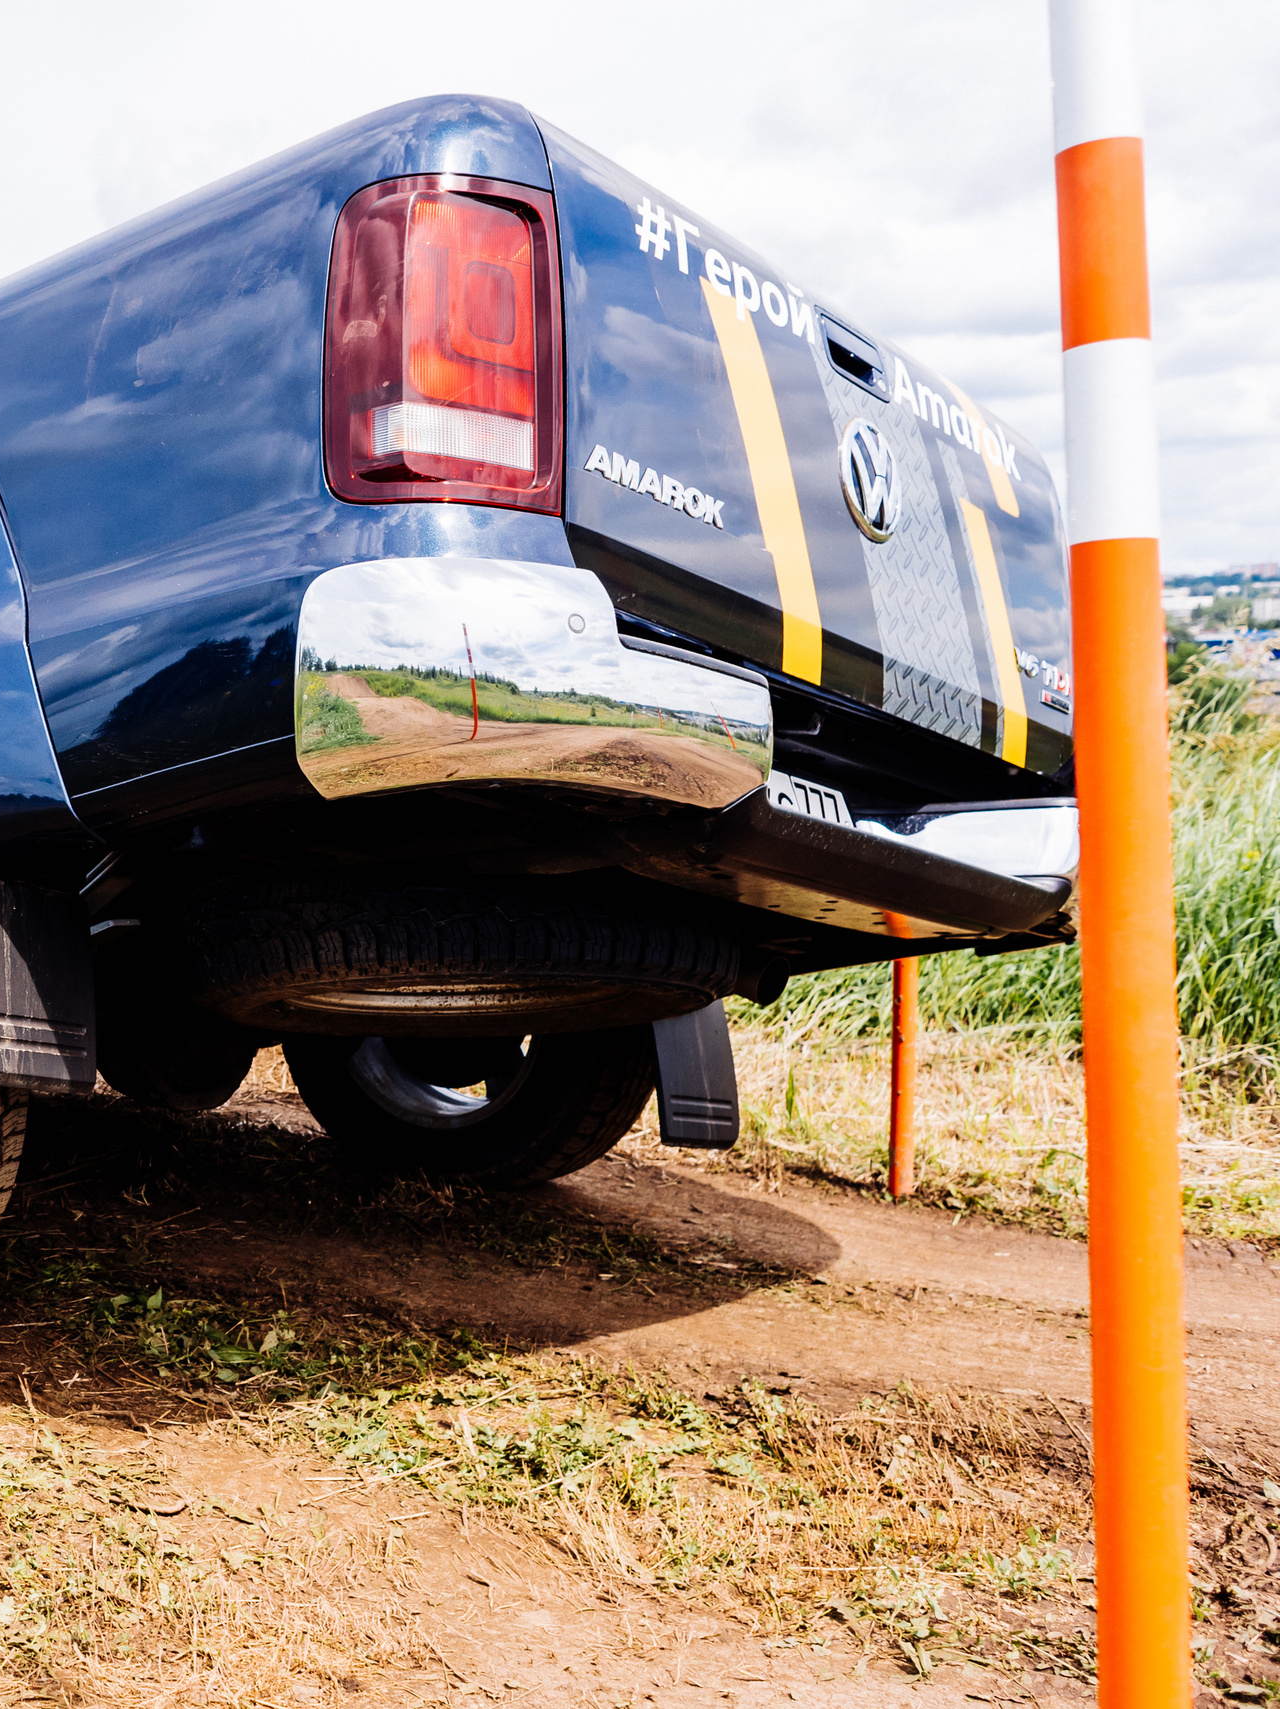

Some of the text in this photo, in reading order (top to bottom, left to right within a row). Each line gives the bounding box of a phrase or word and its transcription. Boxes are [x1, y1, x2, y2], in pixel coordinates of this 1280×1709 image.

[635, 197, 816, 345] #Герой
[890, 357, 1022, 481] Amarok
[584, 443, 725, 530] AMAROK
